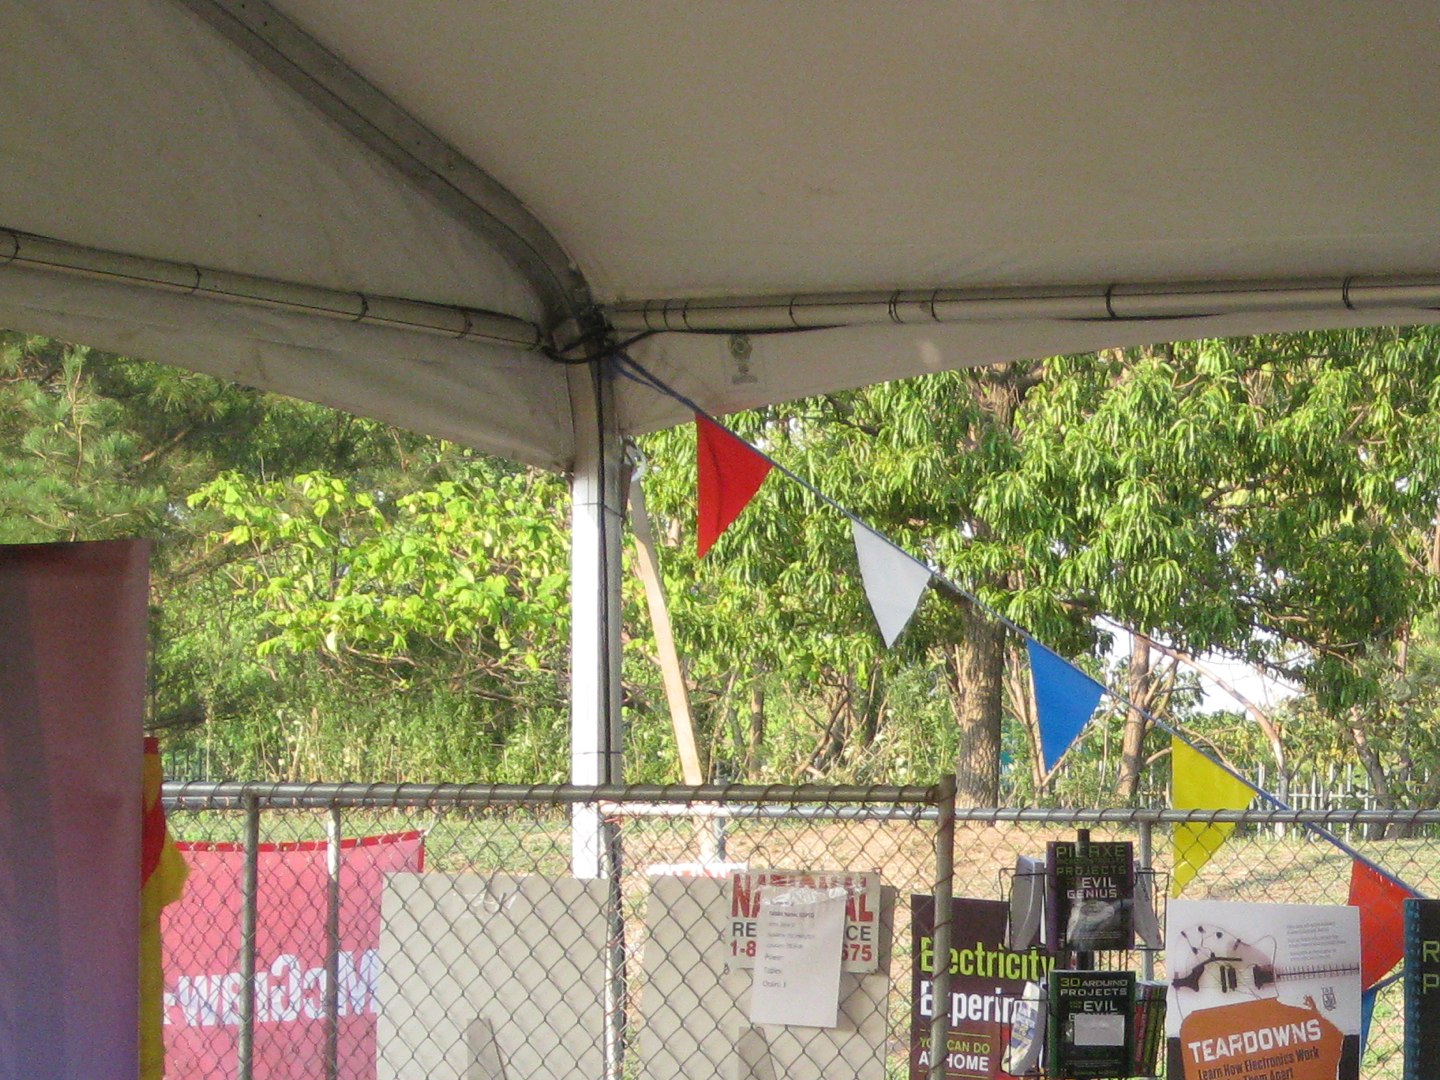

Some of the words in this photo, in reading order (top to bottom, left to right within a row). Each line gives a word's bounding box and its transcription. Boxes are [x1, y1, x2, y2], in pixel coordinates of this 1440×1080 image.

[1056, 866, 1126, 876] PROJECTS
[1082, 877, 1116, 888] EVIL
[1067, 888, 1118, 899] GENIUS
[921, 936, 1055, 981] Eectricity
[1060, 988, 1128, 996] PROJECTS
[1084, 1000, 1118, 1012] EVIL
[946, 1040, 970, 1053] CAN
[973, 1042, 990, 1054] DO
[1187, 1018, 1322, 1064] TEARDOWNS
[1223, 1063, 1243, 1077] How
[1244, 1053, 1295, 1073] Electronics
[1296, 1046, 1320, 1062] Work
